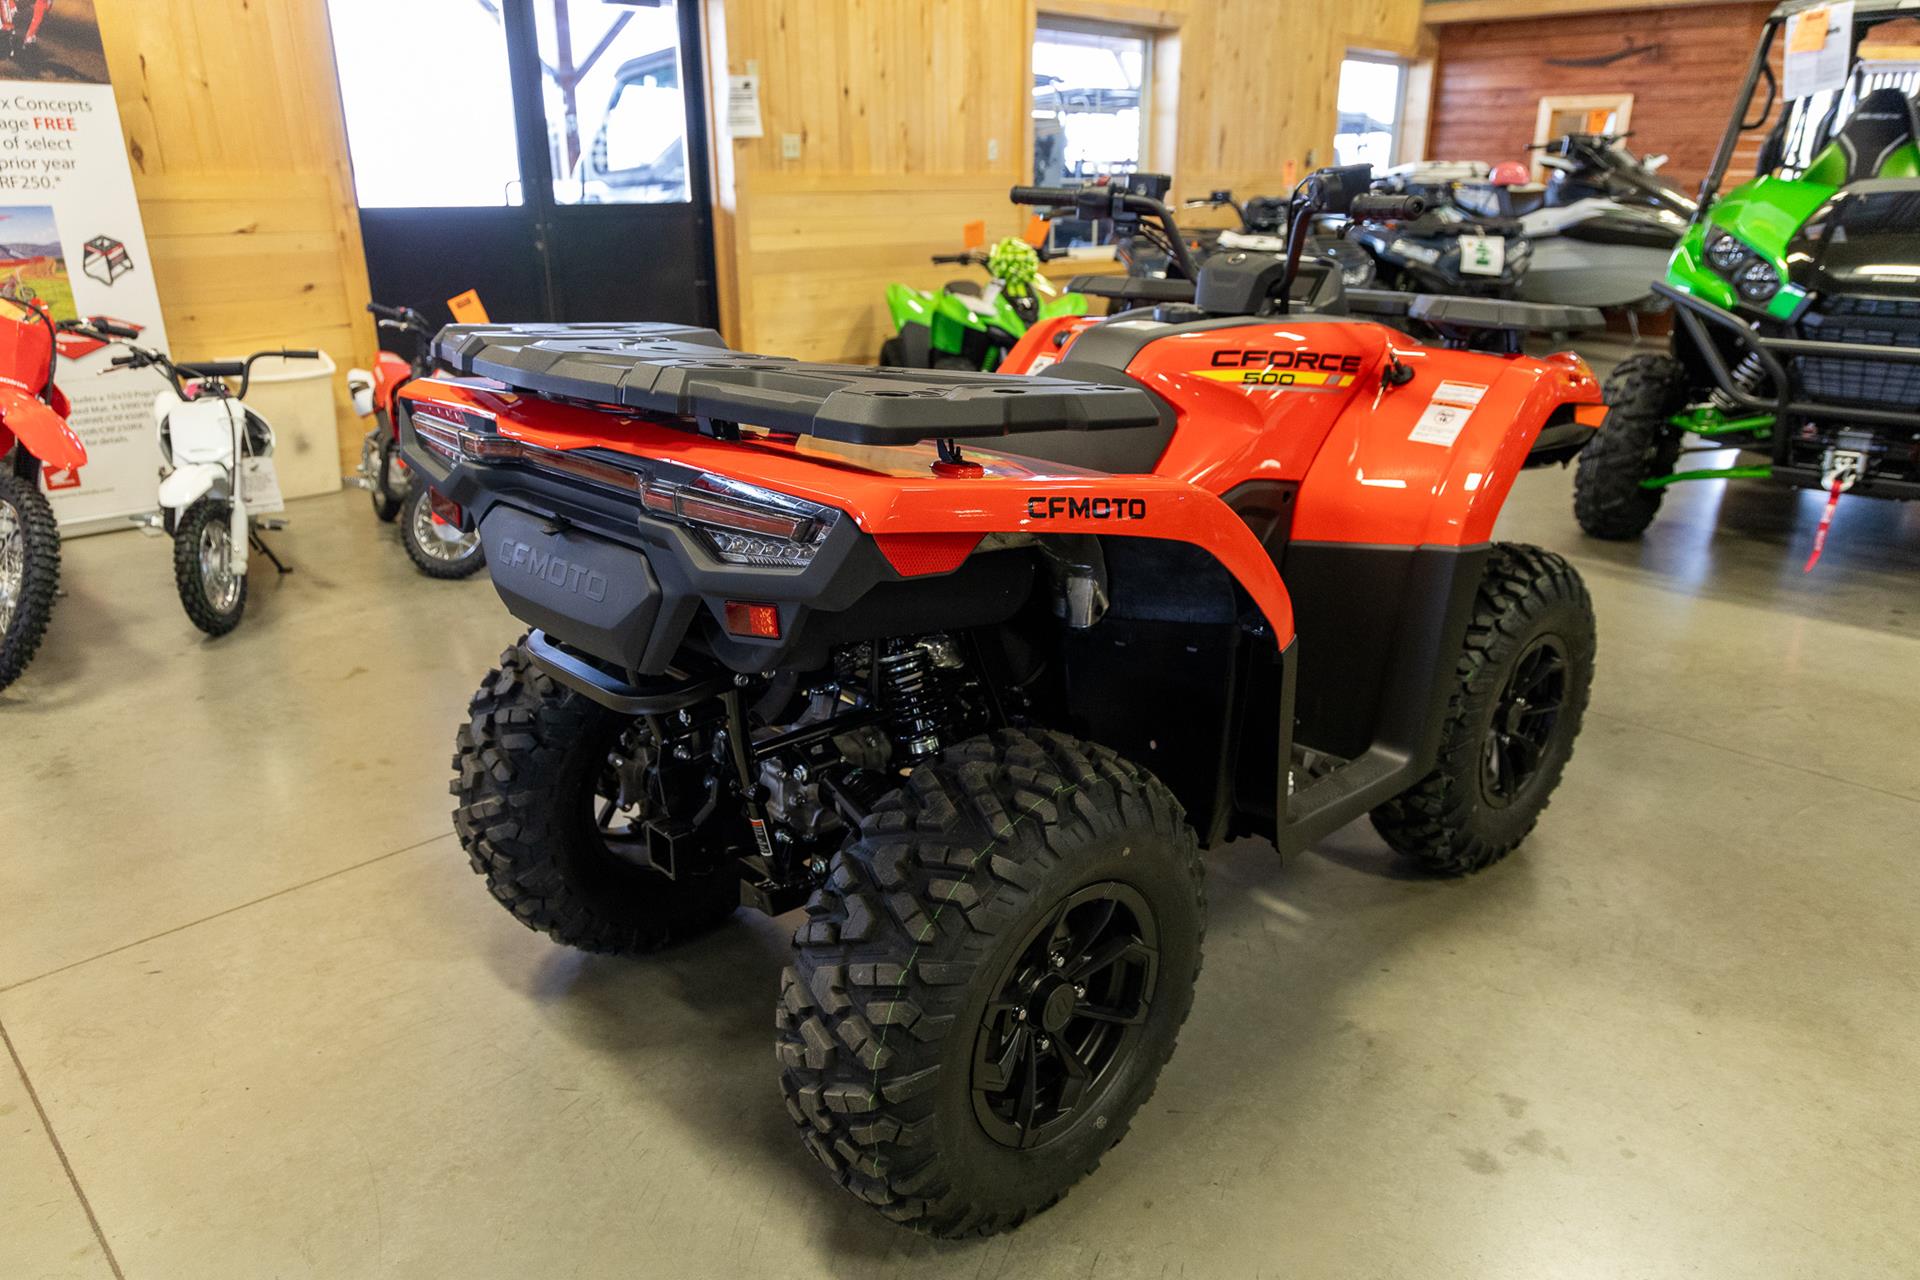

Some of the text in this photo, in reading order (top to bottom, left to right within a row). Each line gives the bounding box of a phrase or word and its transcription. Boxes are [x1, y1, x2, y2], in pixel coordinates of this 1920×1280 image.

[15, 96, 92, 114] Concepts
[33, 116, 78, 131] FREE
[3, 136, 72, 151] of select
[42, 159, 76, 173] year
[1211, 350, 1361, 373] CFORCE
[1242, 372, 1296, 386] 500
[1027, 496, 1146, 520] CFMOTO
[499, 540, 609, 603] CFMOTO
